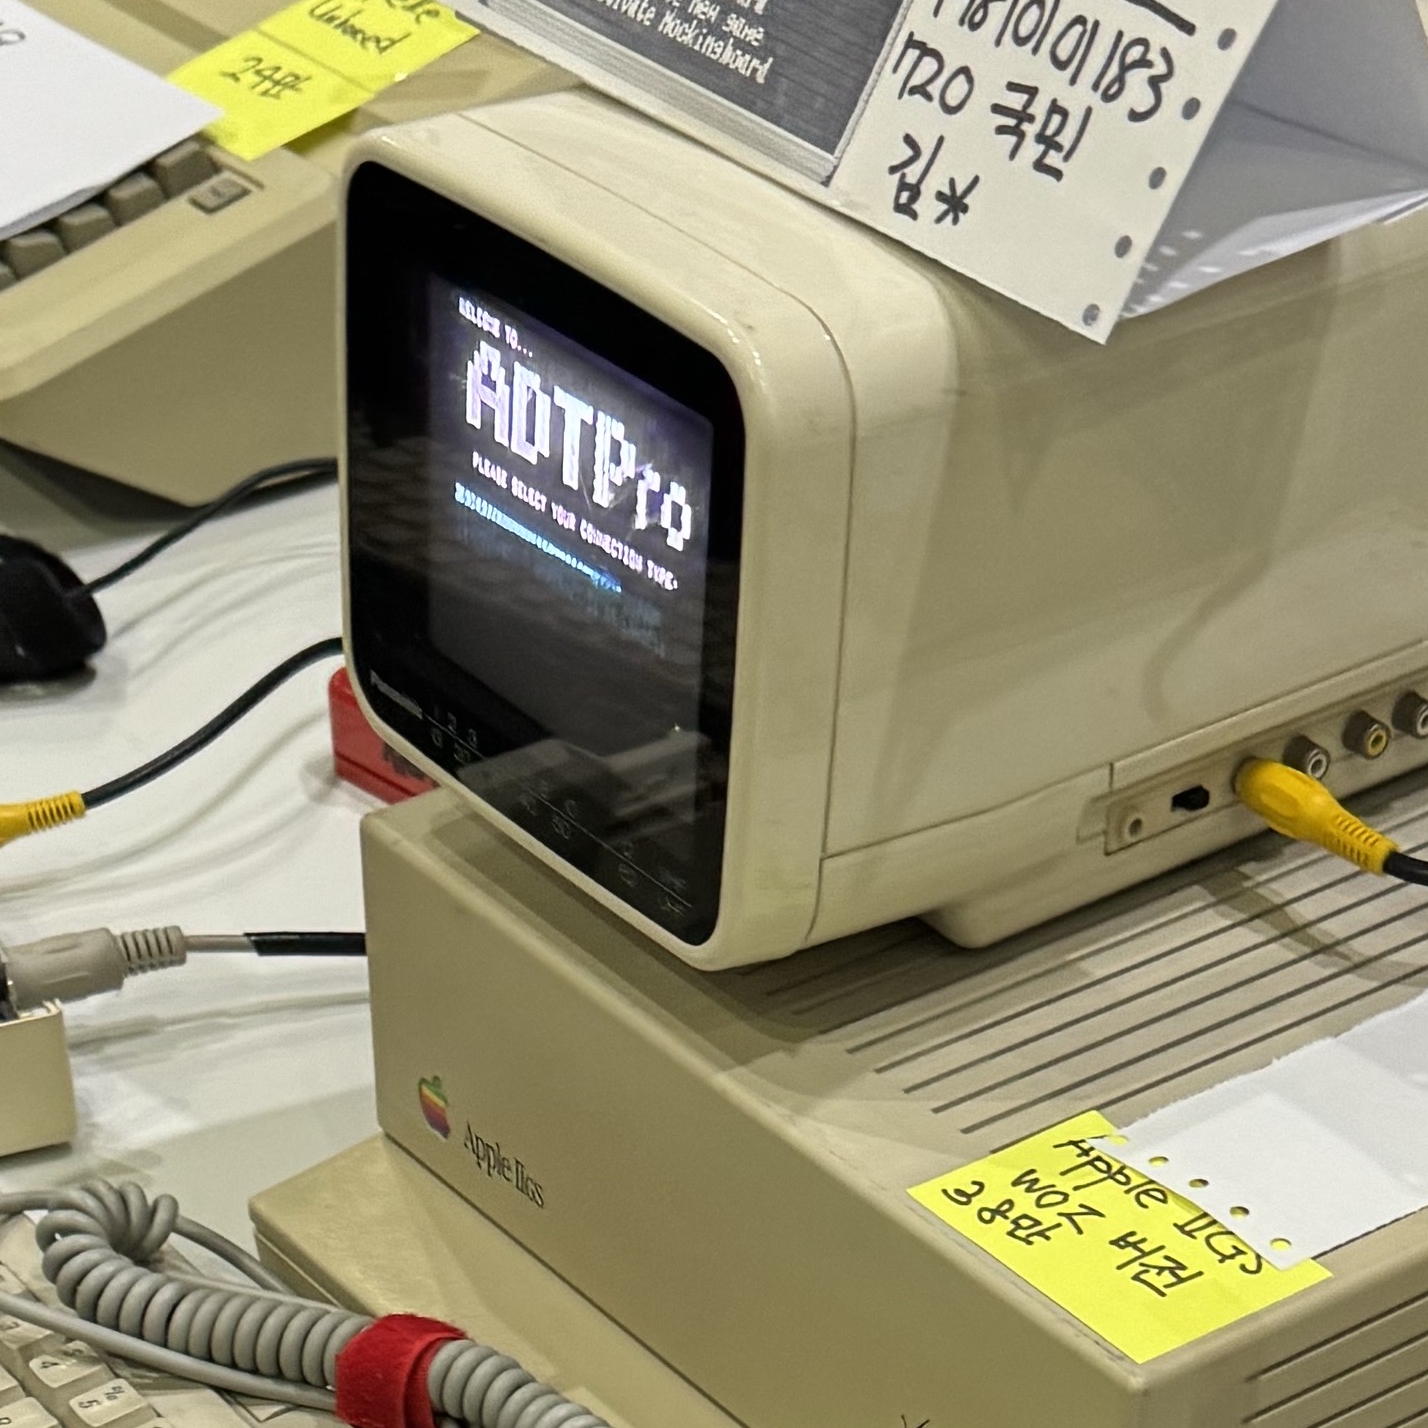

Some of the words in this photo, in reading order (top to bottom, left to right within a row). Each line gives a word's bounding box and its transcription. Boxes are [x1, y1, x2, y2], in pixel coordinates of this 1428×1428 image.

[658, 5, 775, 85] Mockingboard
[990, 80, 1093, 182] 국민
[465, 340, 692, 552] ADTPro
[472, 450, 509, 490] PLEASE
[511, 475, 548, 513] SELECT
[579, 518, 644, 573] CONNECTION
[464, 1118, 512, 1184] Apple
[1053, 1135, 1169, 1209] Apple
[942, 1180, 1063, 1246] 38만
[1011, 1169, 1106, 1235] WOZ
[1108, 1230, 1205, 1298] 버전
[78, 1399, 102, 1409] 5
